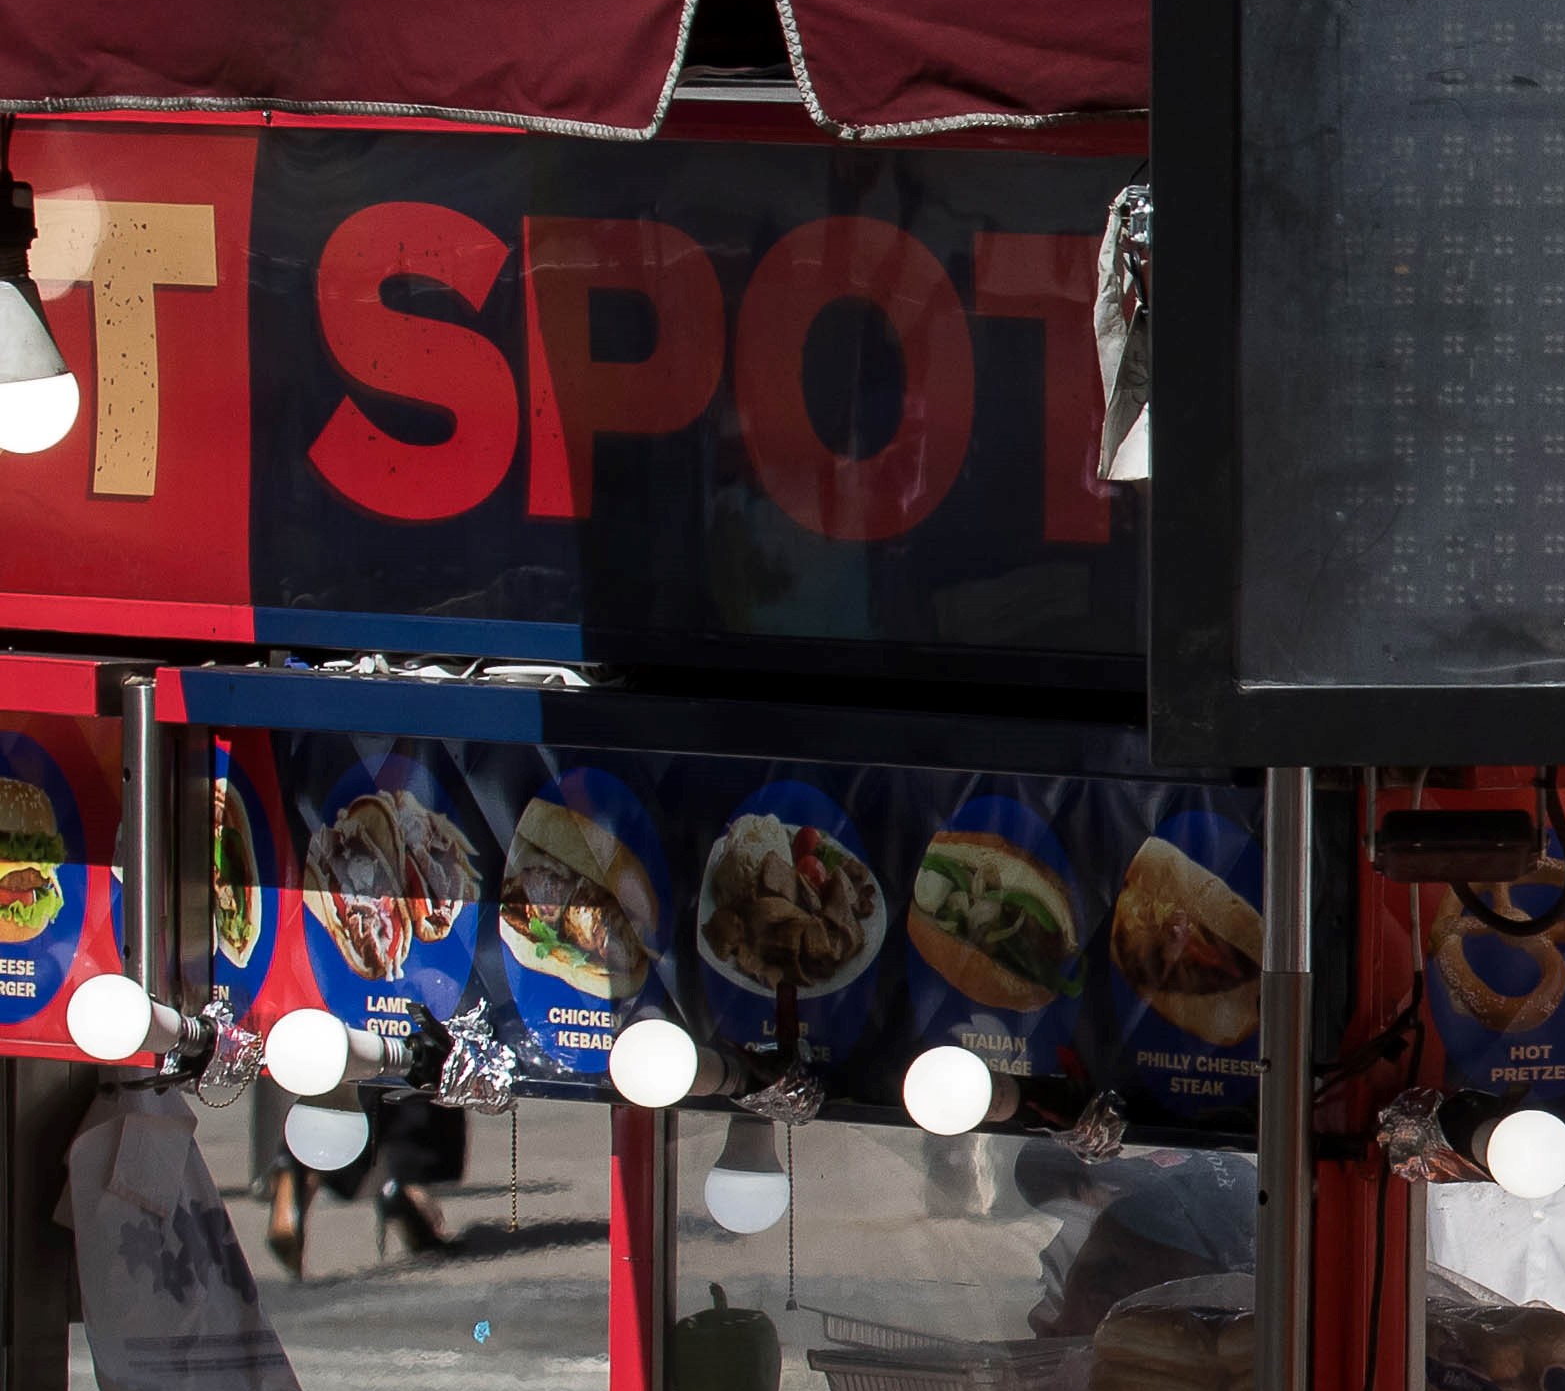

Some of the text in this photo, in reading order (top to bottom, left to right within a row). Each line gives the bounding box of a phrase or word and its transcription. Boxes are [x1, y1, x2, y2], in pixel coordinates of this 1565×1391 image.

[306, 201, 1112, 545] SPOT
[366, 1017, 411, 1037] GYRO
[548, 1007, 621, 1029] CHICKEN
[961, 1033, 1027, 1052] ITALIAN
[1136, 1051, 1191, 1073] PHILLY
[1510, 1046, 1553, 1061] HOT
[1169, 1076, 1225, 1096] STEAK
